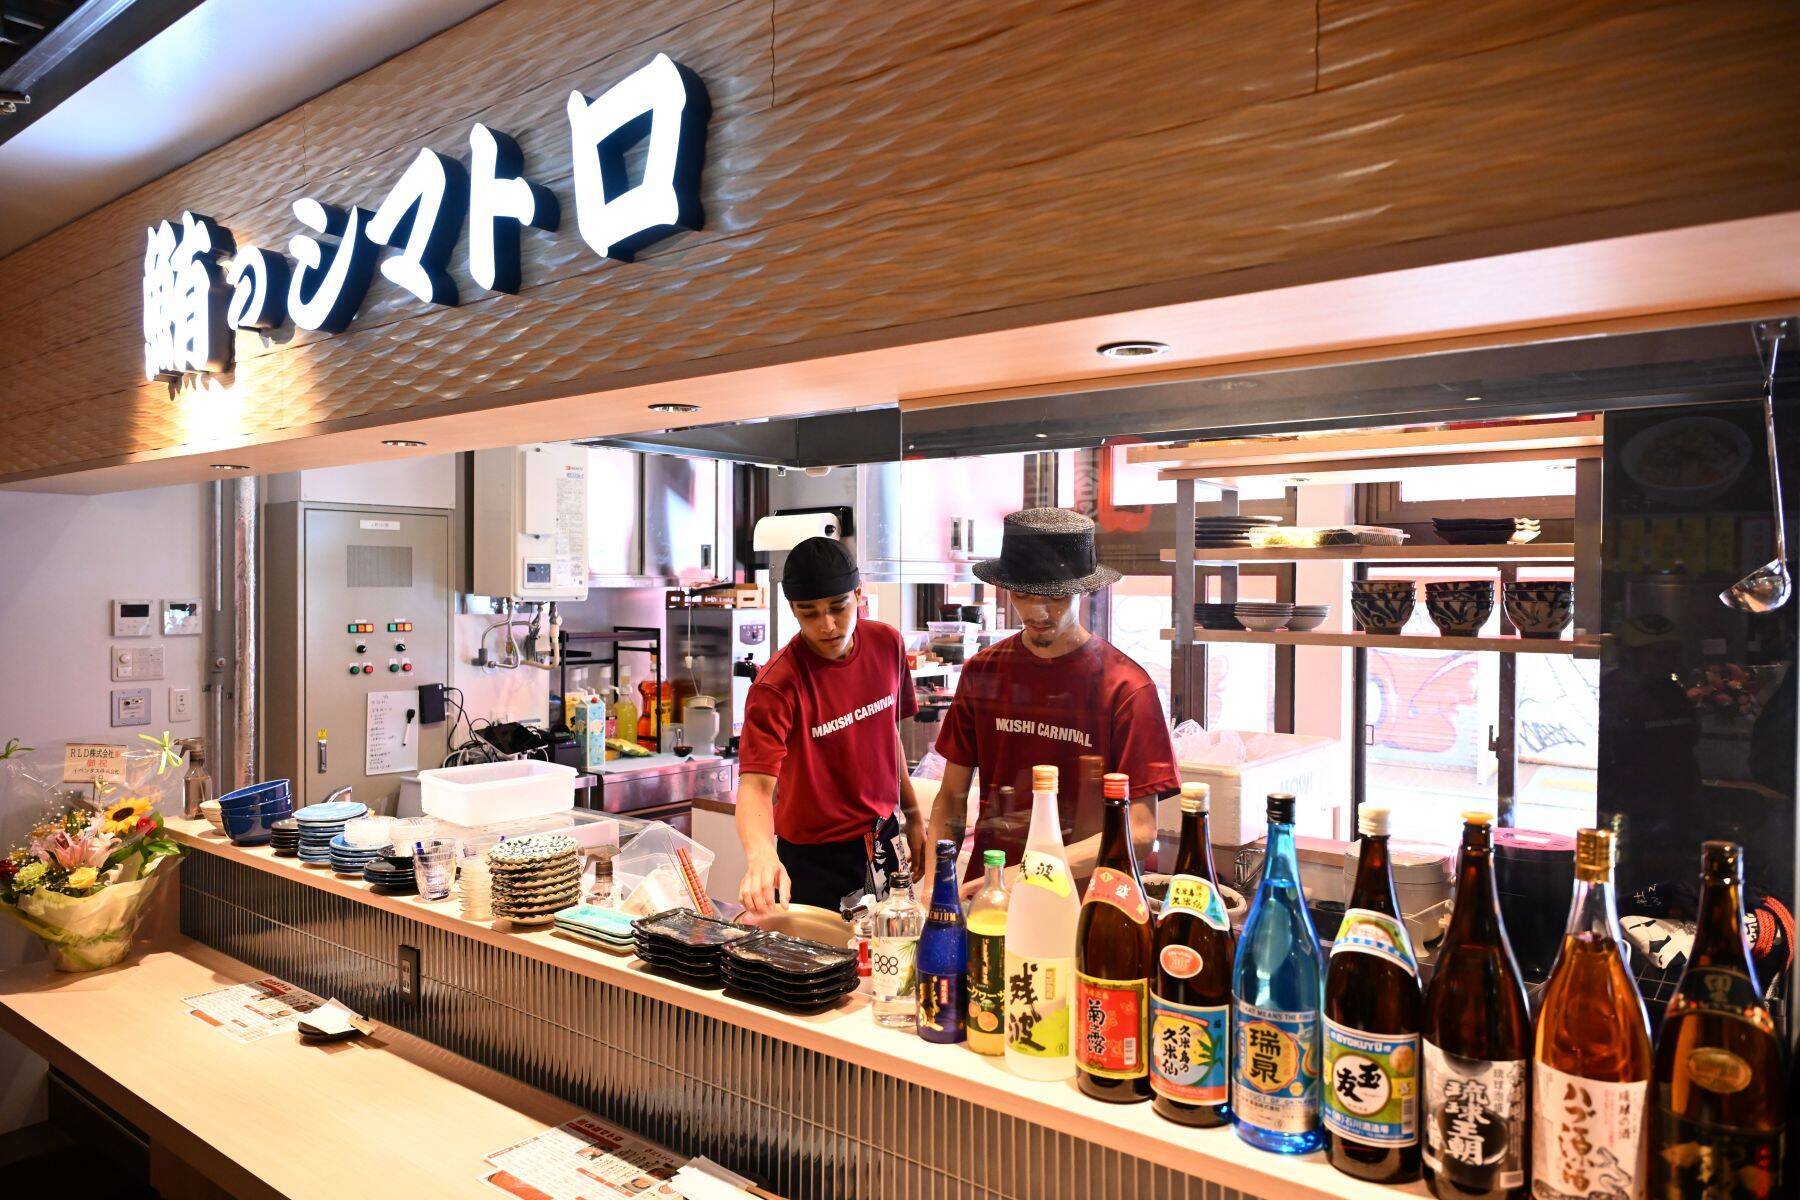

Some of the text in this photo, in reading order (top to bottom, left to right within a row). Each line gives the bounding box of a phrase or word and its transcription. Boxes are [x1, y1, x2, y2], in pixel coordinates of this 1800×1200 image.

[811, 692, 895, 738] MAKISHI CARNIVAL
[1037, 722, 1093, 748] CARNIVAL
[1008, 962, 1047, 1052] 残波
[1087, 998, 1107, 1055] 菊之露
[1162, 1027, 1179, 1076] 久米仙
[1178, 1025, 1192, 1074] 久米島の
[1249, 1027, 1283, 1084] 瑞泉
[1443, 1079, 1491, 1166] 琉球王朝
